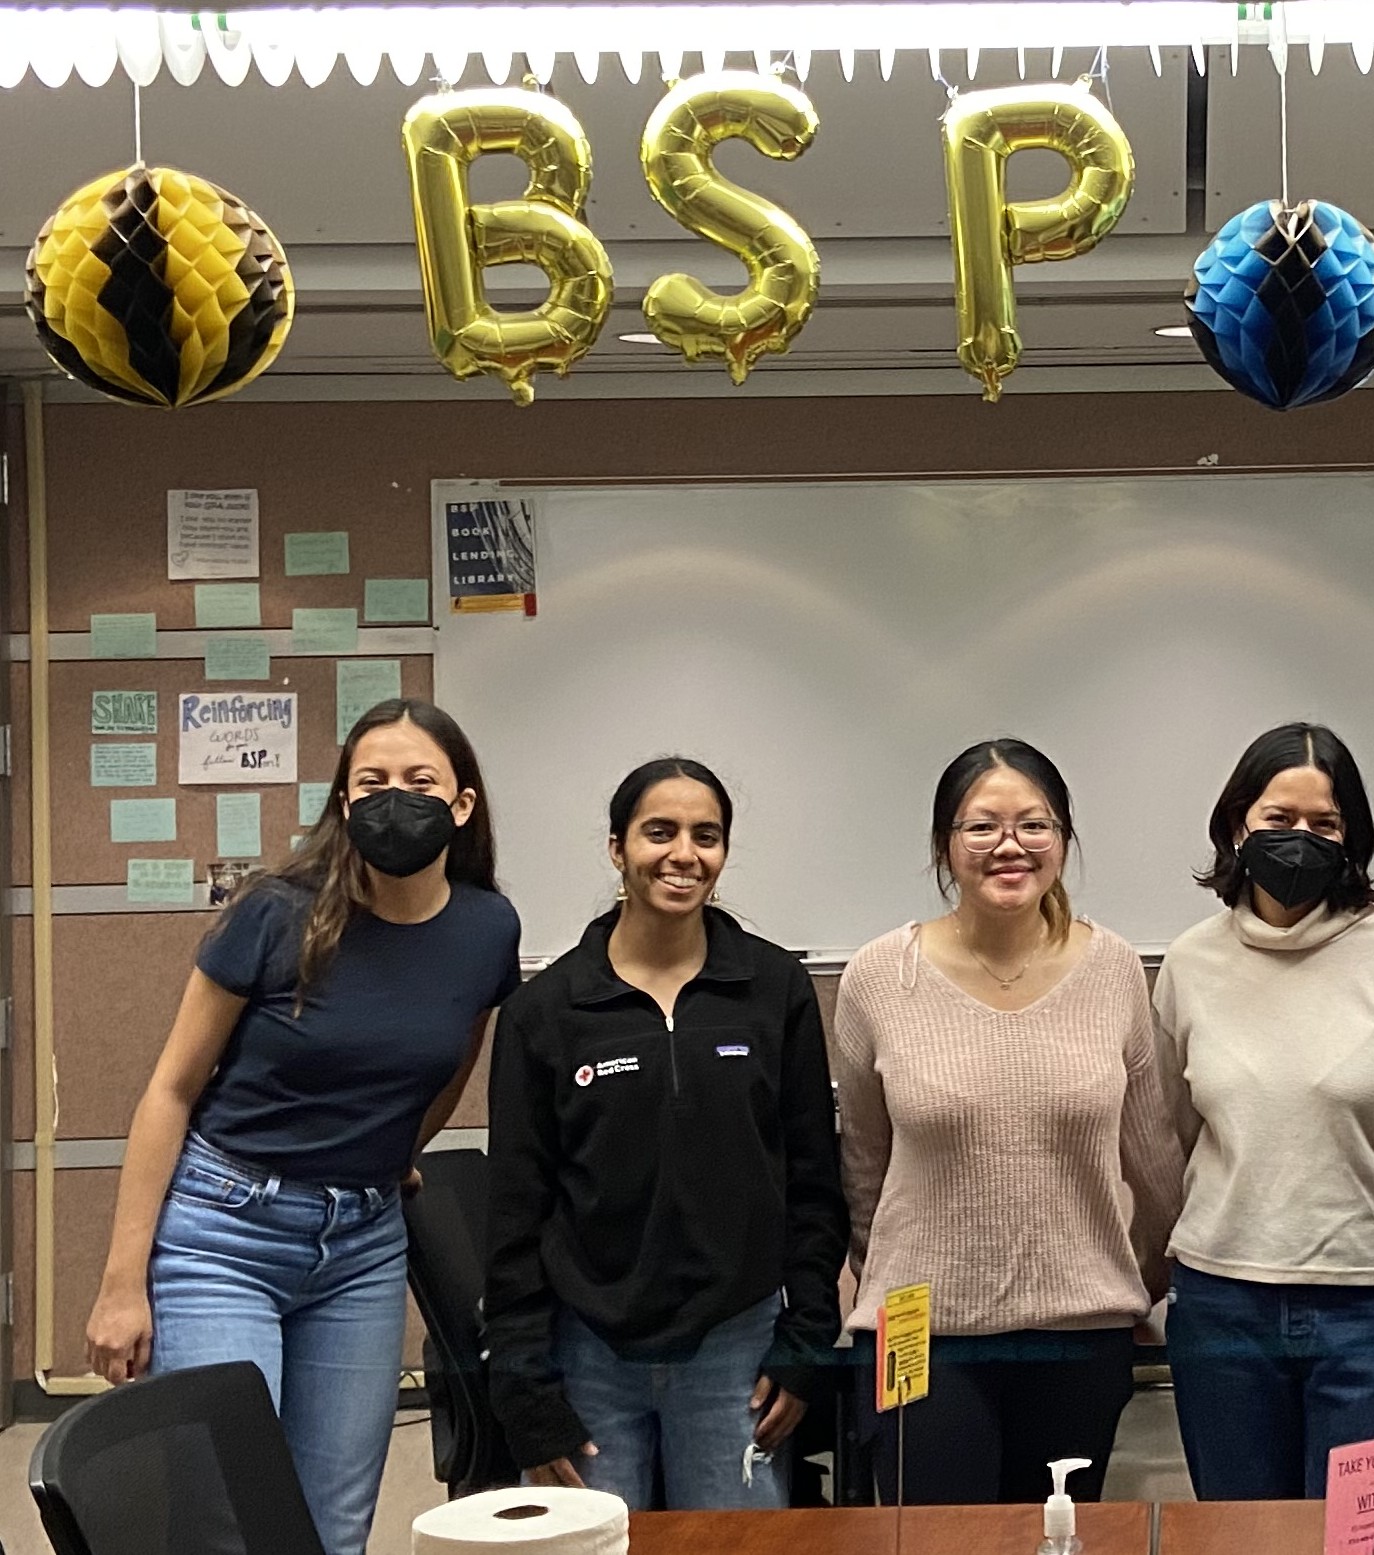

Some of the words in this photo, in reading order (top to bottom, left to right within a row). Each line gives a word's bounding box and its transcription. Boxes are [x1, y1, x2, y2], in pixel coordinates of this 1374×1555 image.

[402, 70, 1137, 405] BSP
[451, 527, 490, 537] BOOK
[452, 550, 515, 561] LENDING
[453, 574, 514, 585] LIBRARY
[182, 695, 292, 732] Reinforcing
[1338, 1457, 1364, 1477] TAKE
